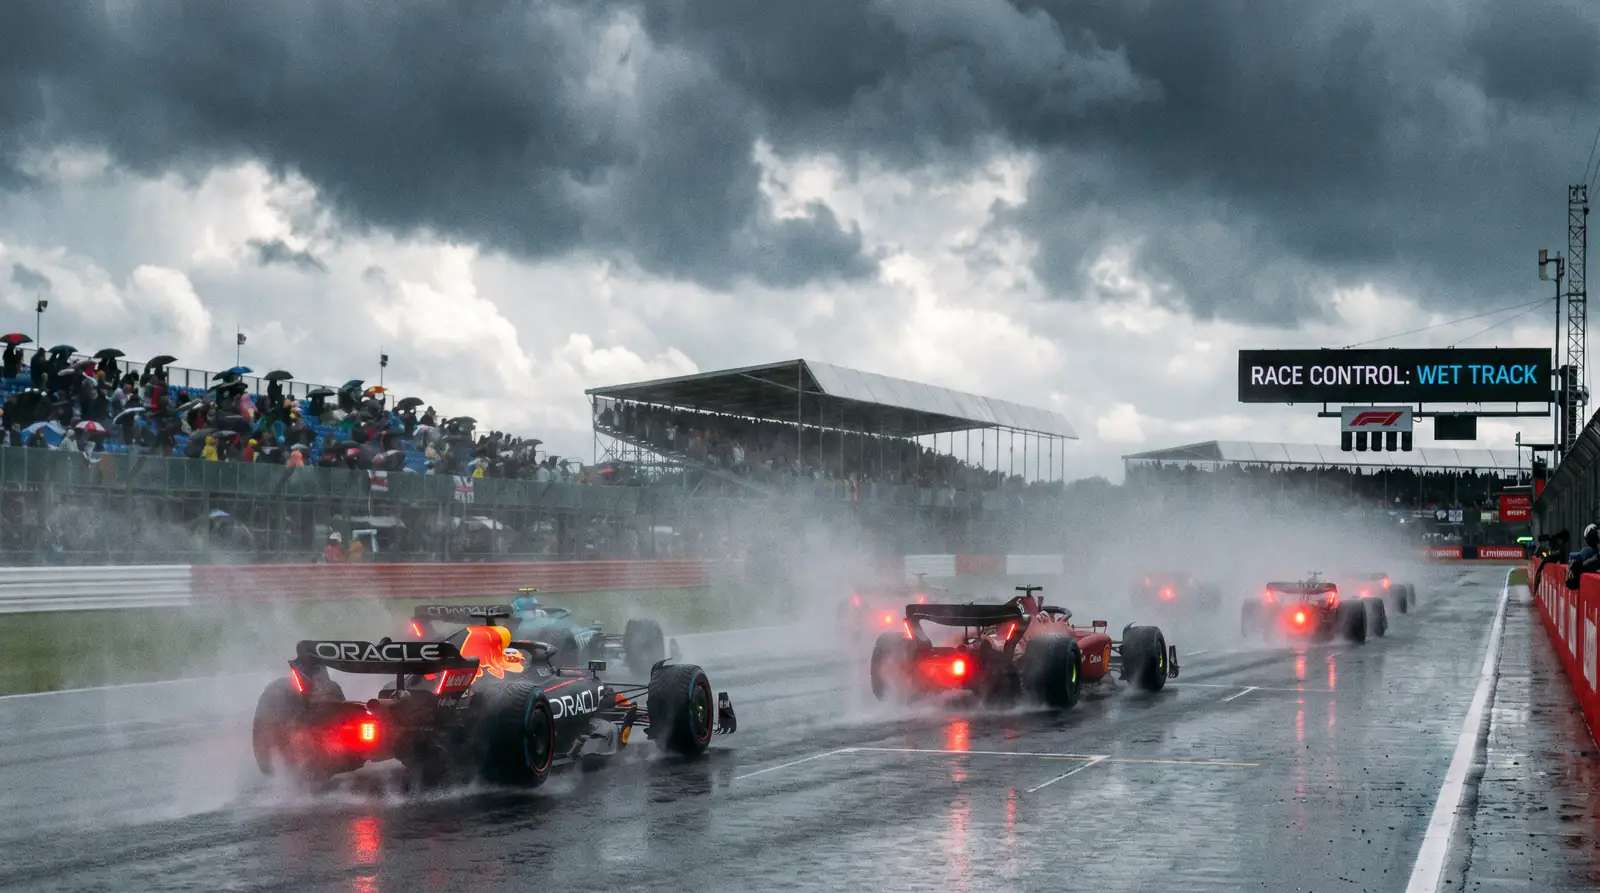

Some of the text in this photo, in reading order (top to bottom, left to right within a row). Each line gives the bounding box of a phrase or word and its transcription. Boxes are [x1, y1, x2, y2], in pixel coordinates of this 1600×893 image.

[1251, 364, 1538, 386] RACE CONTROL: WET TRACK
[315, 642, 440, 661] ORACLE
